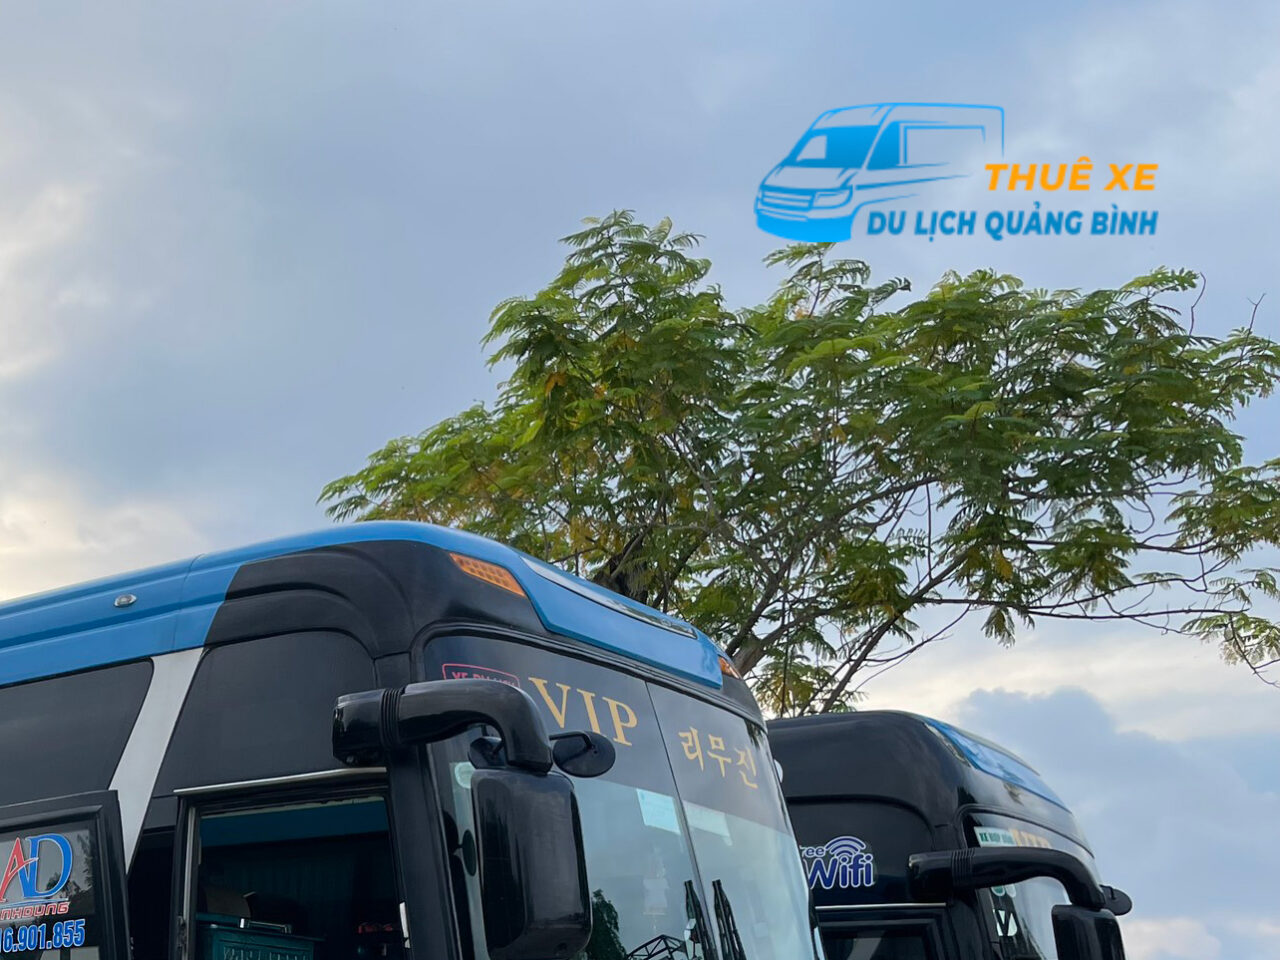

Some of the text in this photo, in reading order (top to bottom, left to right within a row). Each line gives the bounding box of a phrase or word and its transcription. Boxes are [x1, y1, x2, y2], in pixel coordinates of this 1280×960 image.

[528, 677, 638, 746] VIP
[678, 726, 759, 789] 리무진
[803, 853, 874, 890] Wifi
